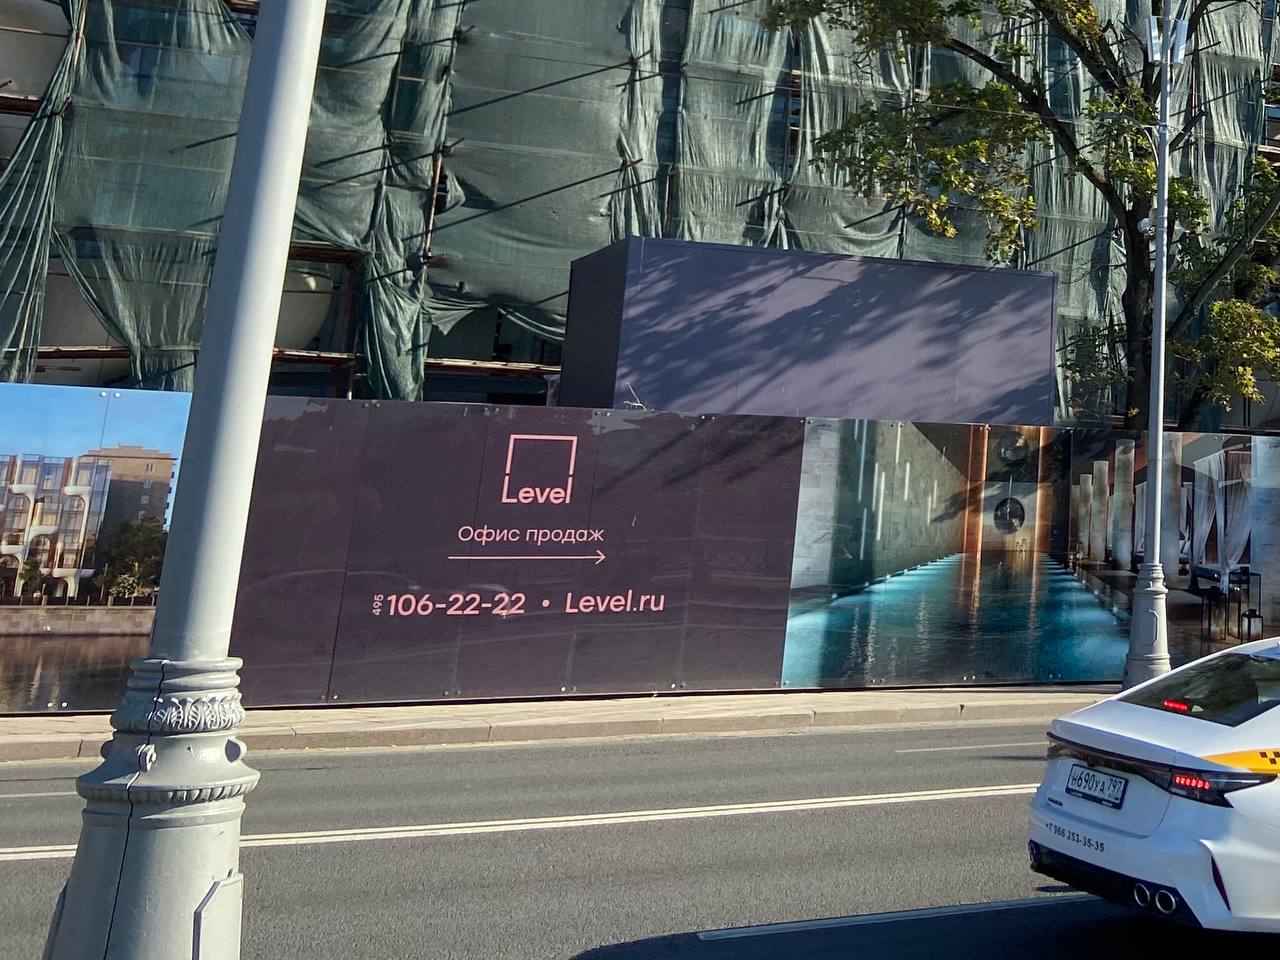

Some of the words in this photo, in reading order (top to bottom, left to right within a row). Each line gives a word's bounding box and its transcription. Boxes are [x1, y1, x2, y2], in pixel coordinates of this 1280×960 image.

[501, 474, 573, 504] Level
[458, 524, 520, 546] Офис
[526, 527, 605, 546] продаж
[372, 594, 384, 616] 495
[386, 592, 527, 617] 106-22-22
[564, 589, 665, 614] Level.ru
